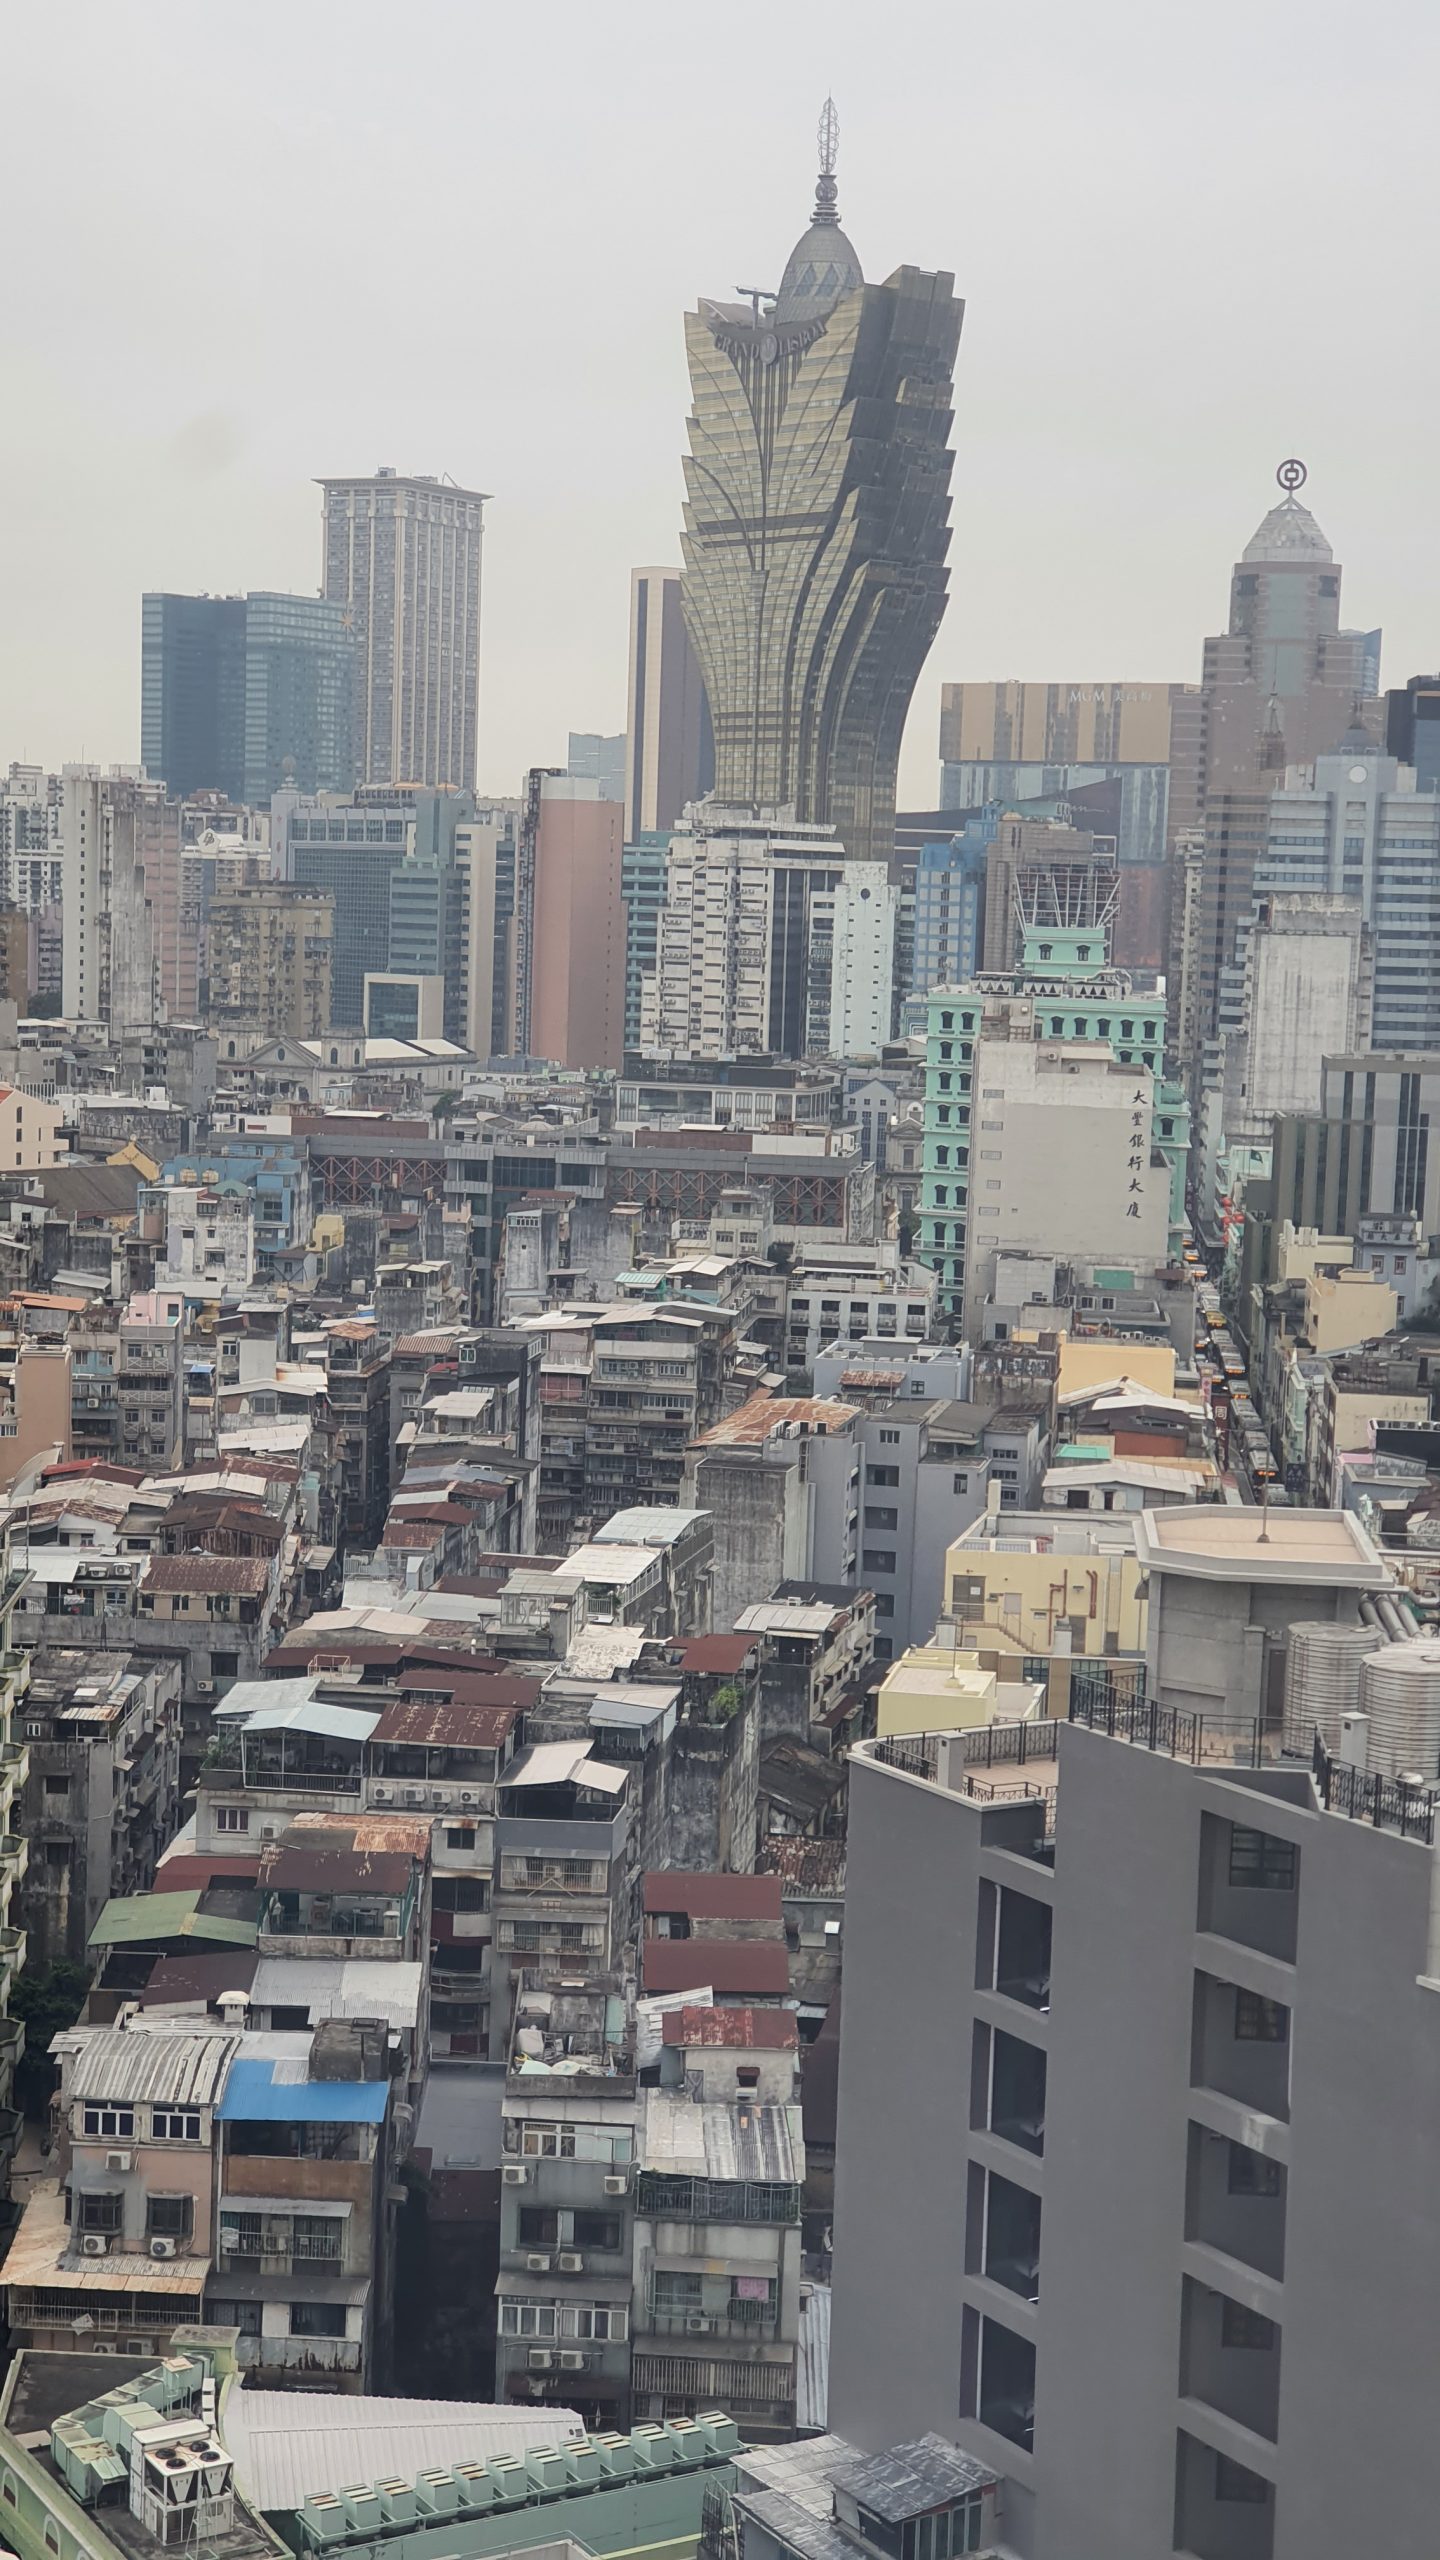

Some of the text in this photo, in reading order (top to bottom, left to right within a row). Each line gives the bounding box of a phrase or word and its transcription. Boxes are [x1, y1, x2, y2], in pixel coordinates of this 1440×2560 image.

[715, 319, 826, 359] GRAND LISBOA
[1070, 688, 1105, 702] MGM
